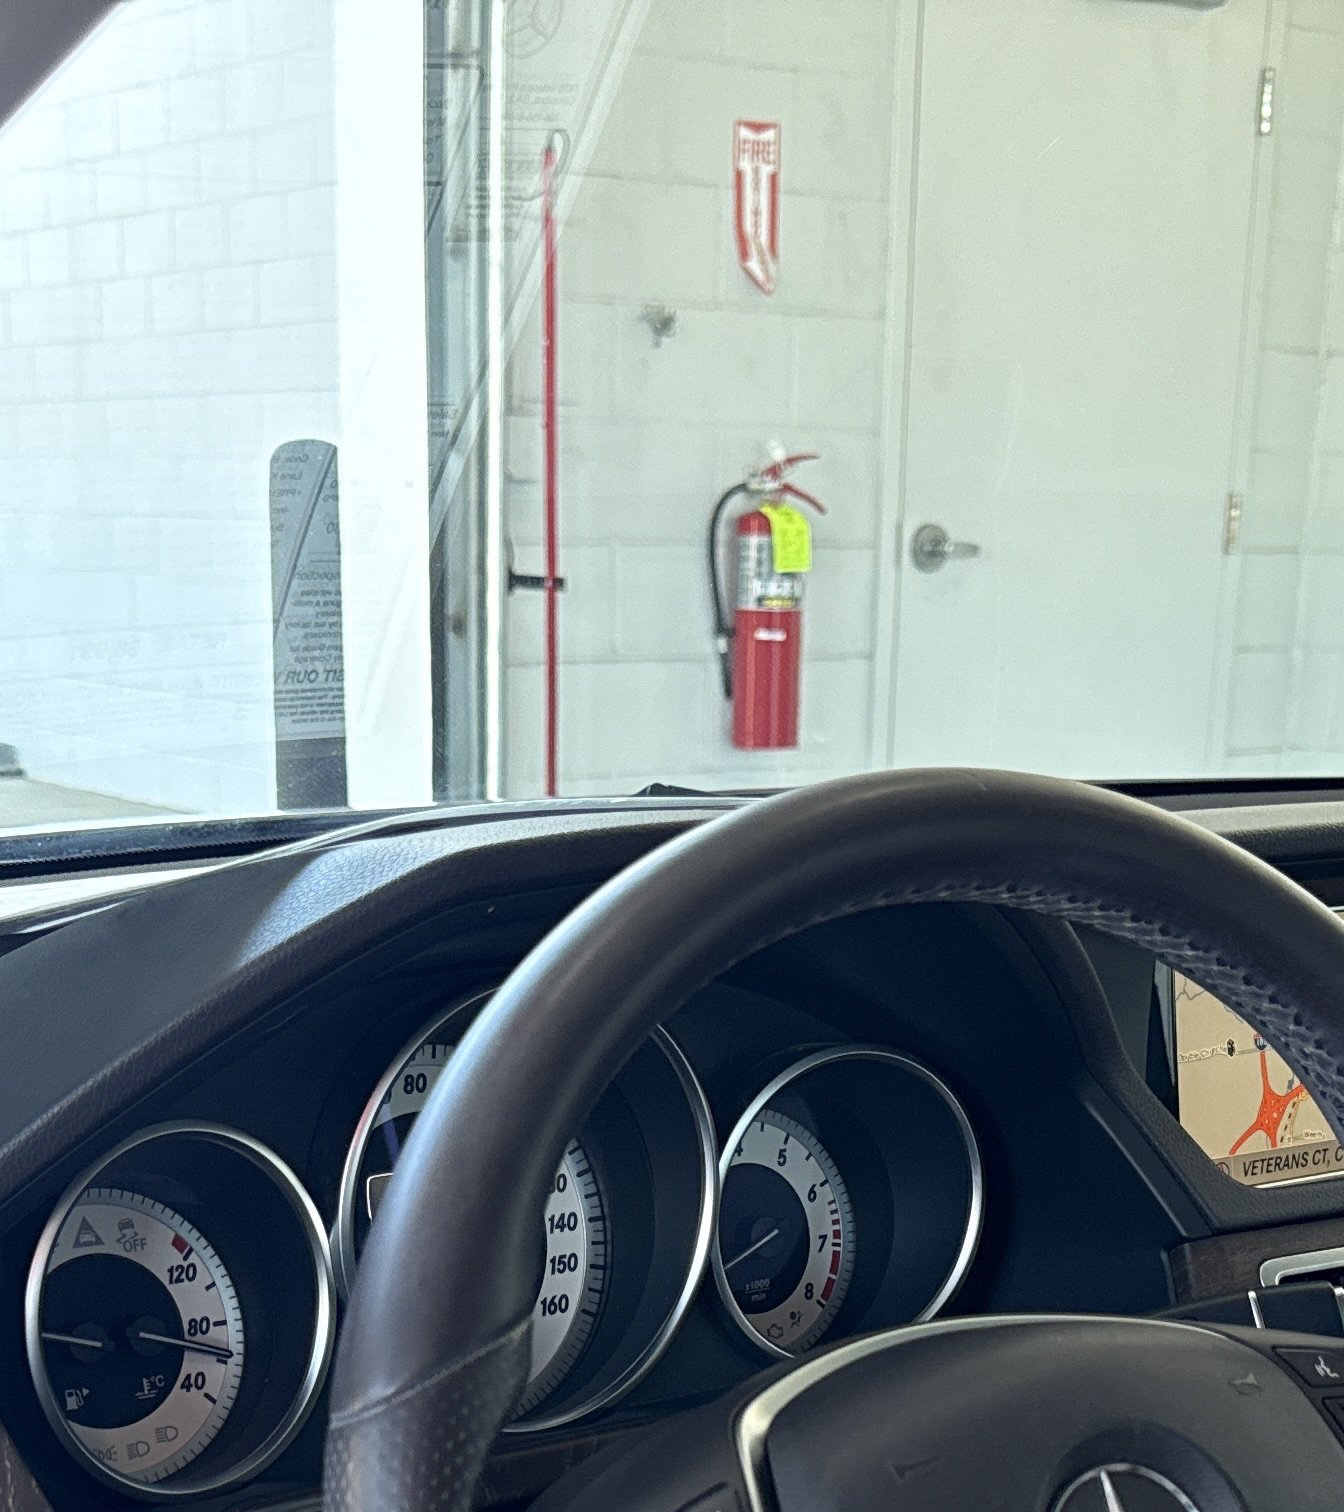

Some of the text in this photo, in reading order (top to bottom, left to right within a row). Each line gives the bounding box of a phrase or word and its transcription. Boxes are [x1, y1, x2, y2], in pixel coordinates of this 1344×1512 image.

[403, 1073, 427, 1094] 80
[777, 1148, 787, 1167] 5
[1243, 1151, 1309, 1178] VETERANS
[1312, 1147, 1331, 1169] CT,
[807, 1183, 817, 1203] 6
[548, 1211, 578, 1234] 140
[122, 1237, 148, 1253] OFF
[817, 1234, 828, 1253] 7
[167, 1262, 197, 1285] 120
[549, 1252, 578, 1275] 150
[804, 1282, 815, 1300] 8
[540, 1293, 570, 1317] 160
[187, 1316, 211, 1337] 80
[180, 1371, 206, 1393] 40
